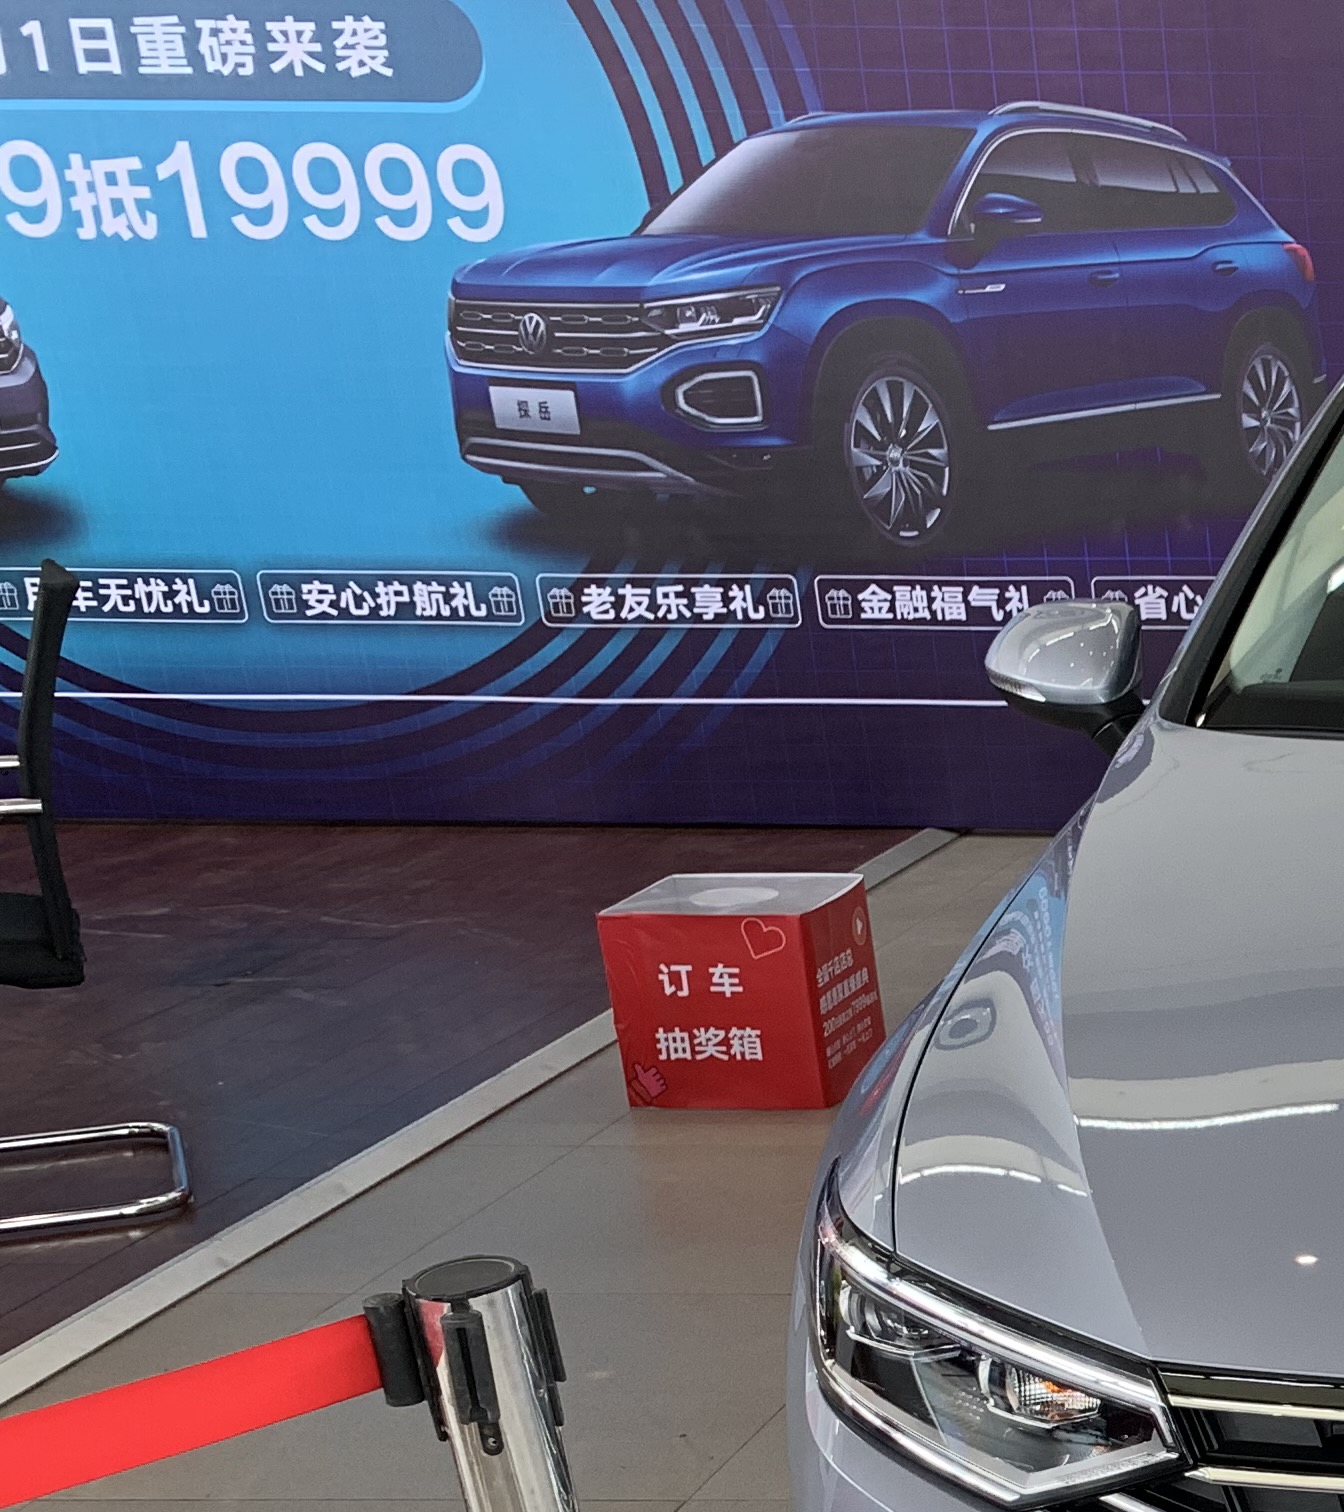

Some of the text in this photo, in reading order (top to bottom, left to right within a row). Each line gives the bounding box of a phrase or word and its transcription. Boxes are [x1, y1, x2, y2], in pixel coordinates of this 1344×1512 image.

[0, 14, 394, 78] 1日重磅来袭
[299, 580, 488, 617] 安心护航礼
[580, 584, 766, 620] 老友乐享礼
[654, 1027, 763, 1062] 抽奖箱
